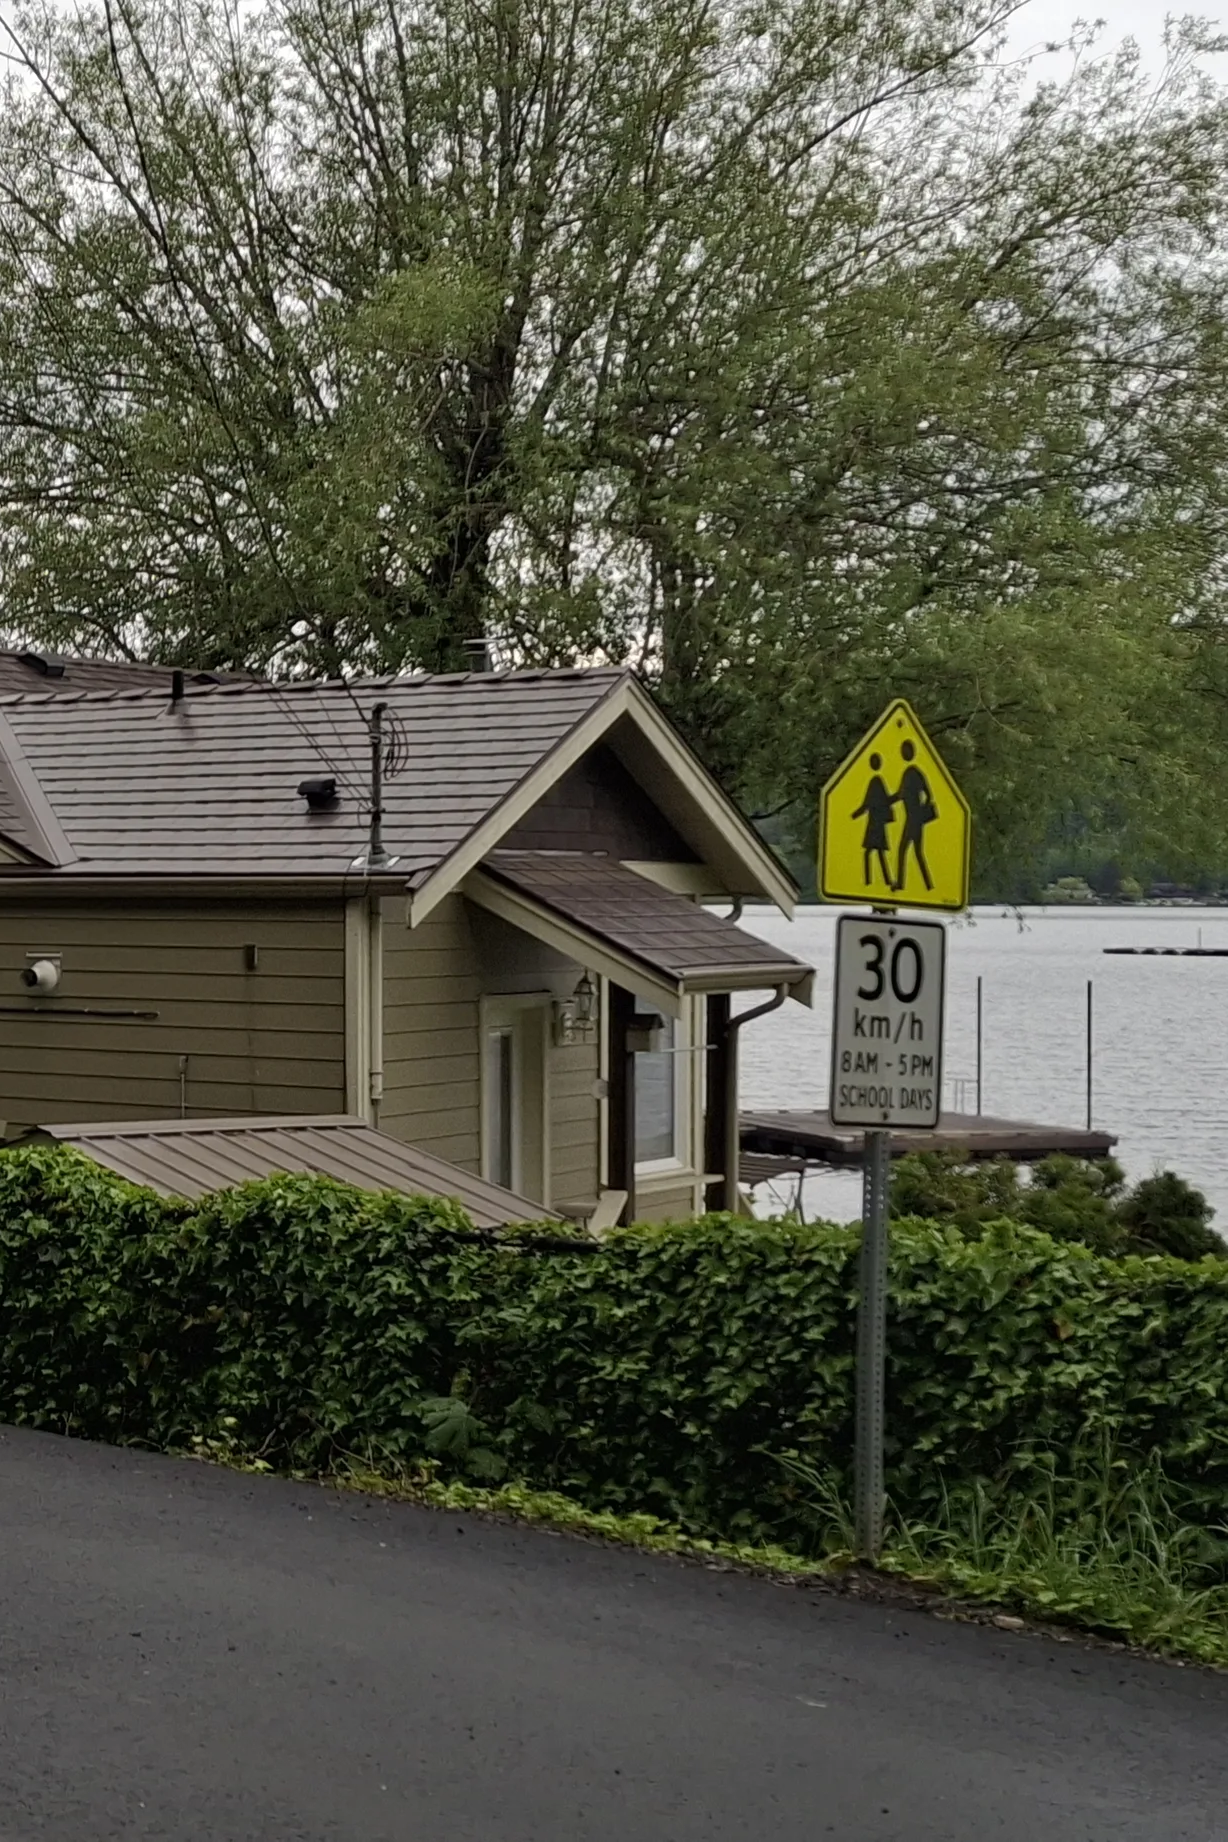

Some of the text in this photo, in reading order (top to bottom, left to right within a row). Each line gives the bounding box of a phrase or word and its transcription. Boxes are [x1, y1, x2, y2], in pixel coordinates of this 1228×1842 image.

[857, 934, 924, 1004] 30
[853, 1007, 923, 1044] km/h
[840, 1084, 932, 1111] SCHOOL DAYS
